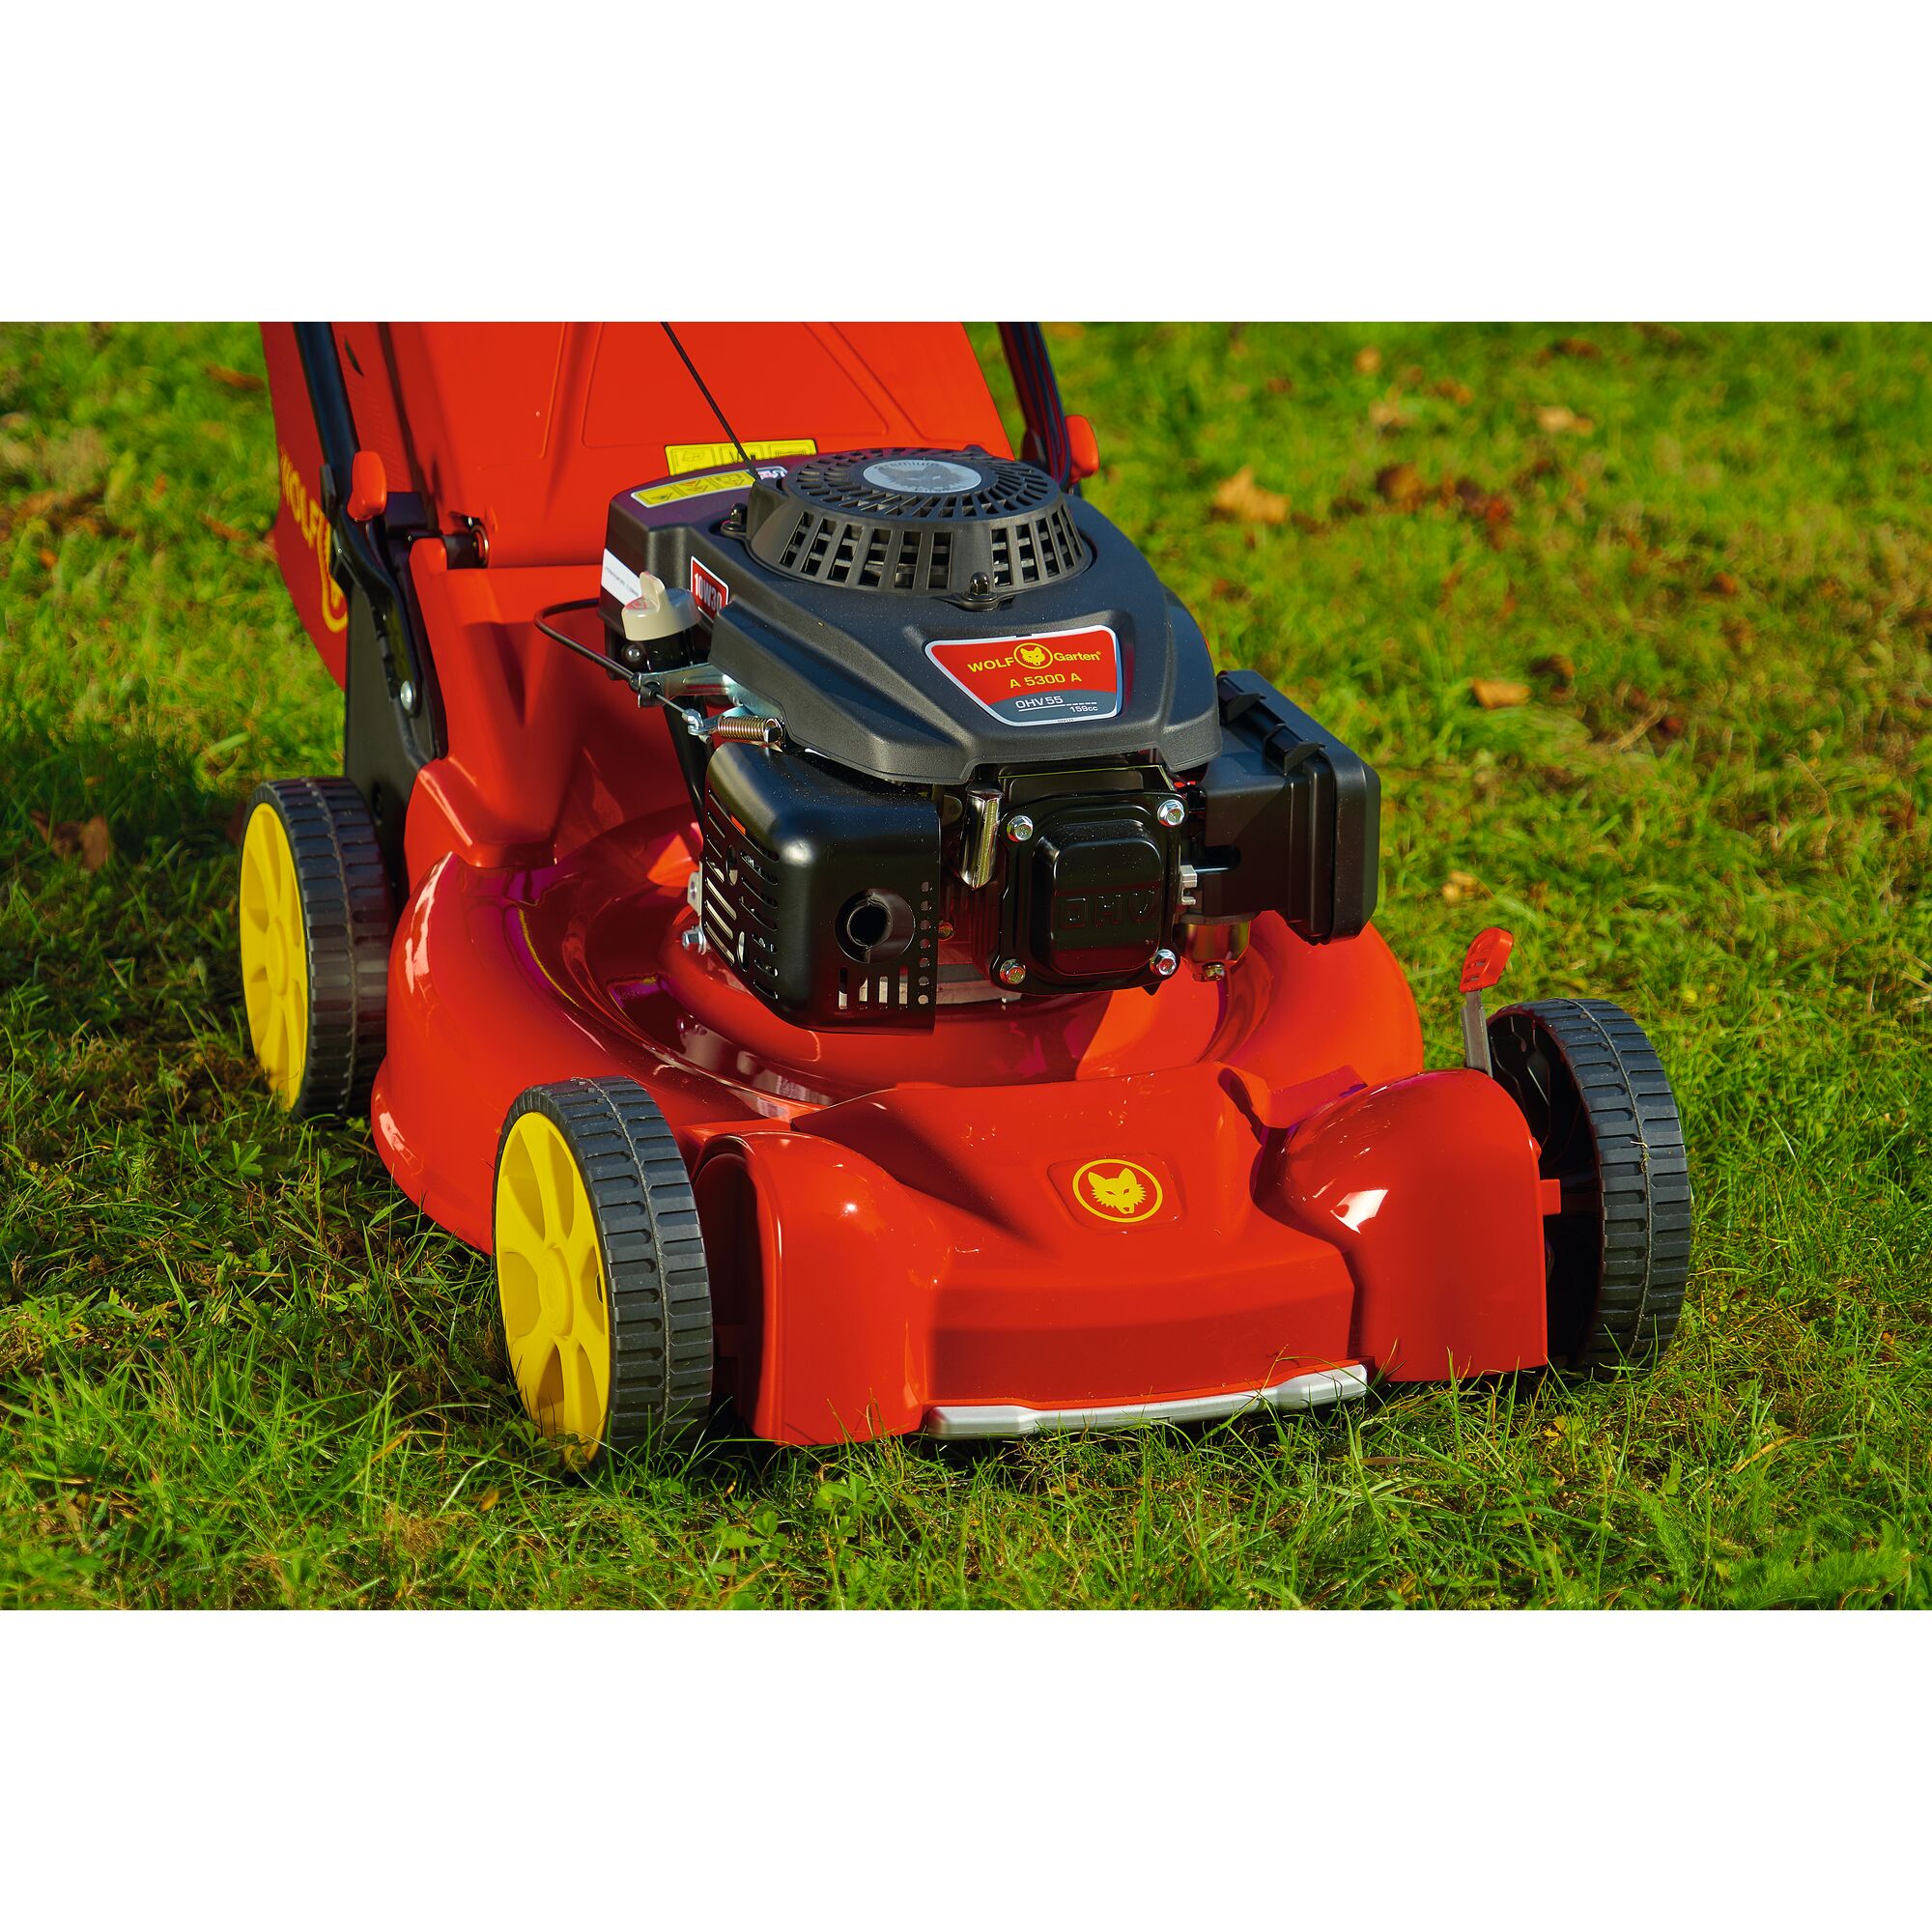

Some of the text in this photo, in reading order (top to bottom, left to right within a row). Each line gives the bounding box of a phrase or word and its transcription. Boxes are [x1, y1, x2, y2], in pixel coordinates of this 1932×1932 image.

[695, 573, 722, 616] 10W30
[967, 657, 1014, 672] WOLF
[1009, 672, 1082, 689] A 5300 A
